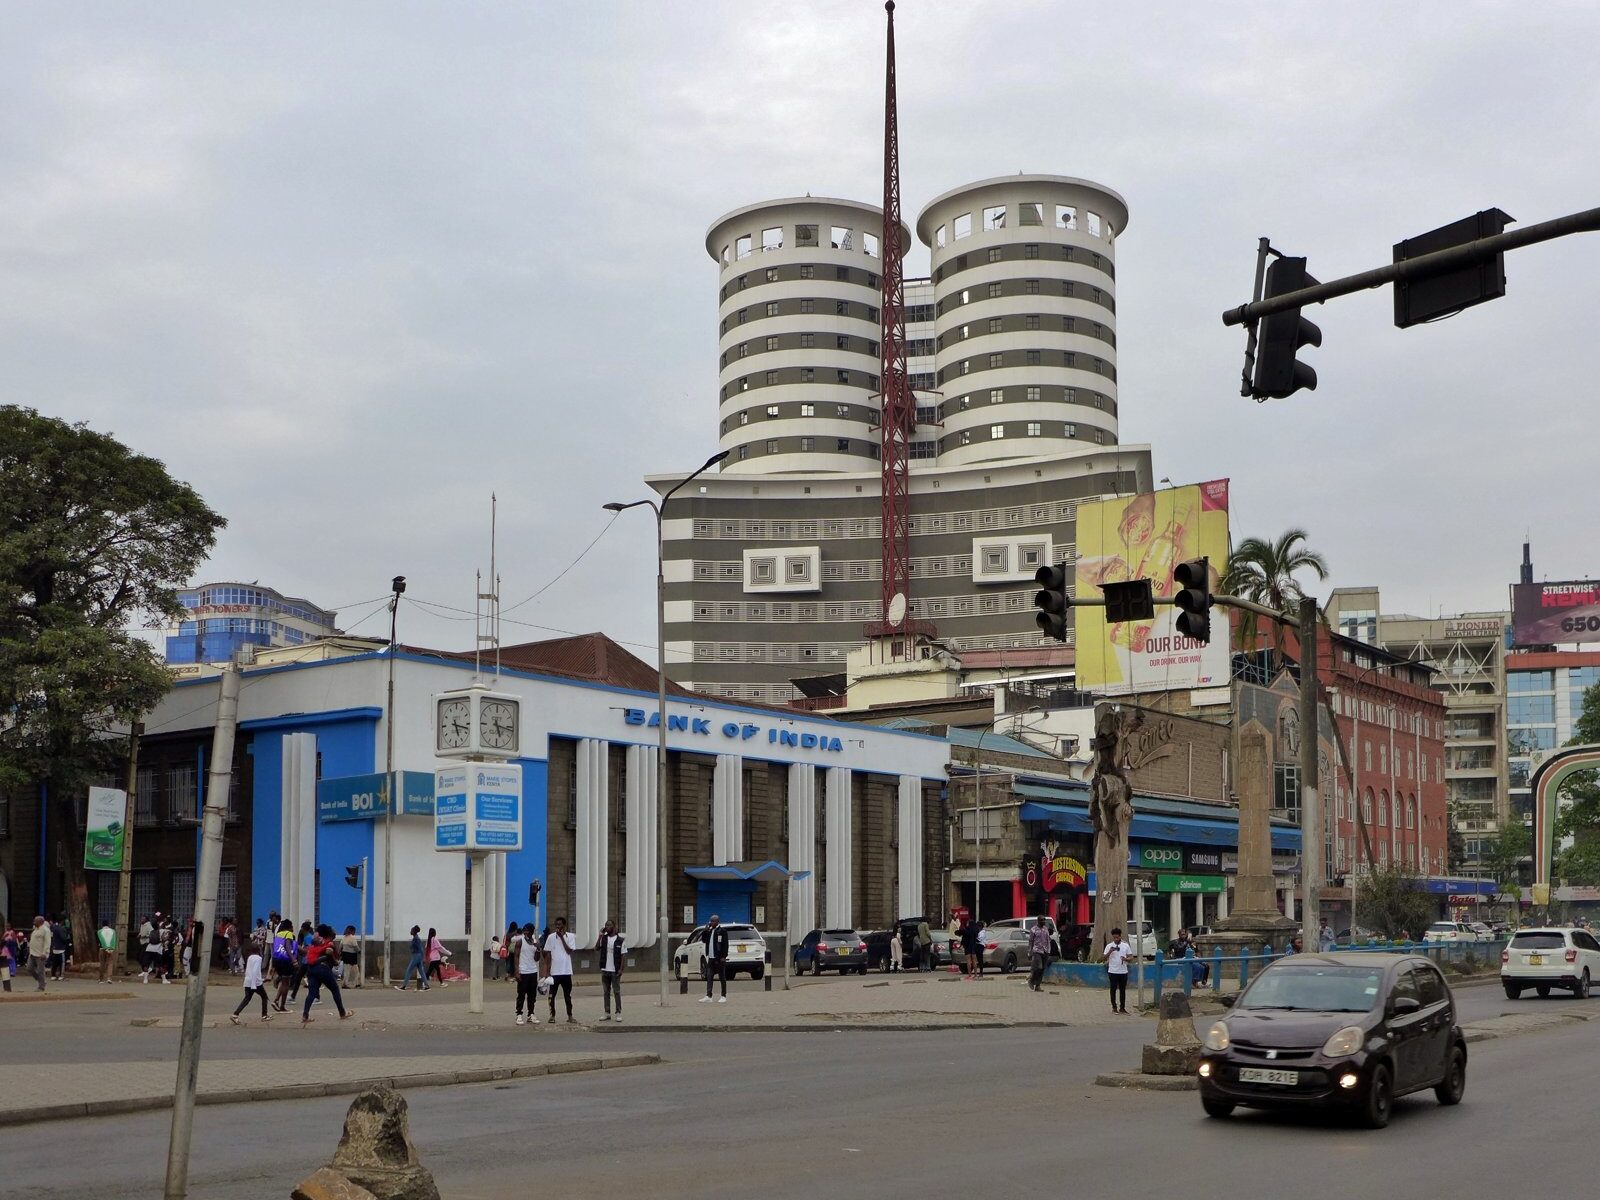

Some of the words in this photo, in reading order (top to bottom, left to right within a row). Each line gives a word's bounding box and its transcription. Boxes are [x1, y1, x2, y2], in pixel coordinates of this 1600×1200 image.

[213, 604, 250, 613] TOWERS
[1456, 621, 1500, 631] PIONEER
[1561, 615, 1600, 633] 650
[1475, 629, 1499, 637] STREET
[1146, 637, 1171, 654] OUR
[1149, 659, 1161, 667] OUR
[1178, 656, 1189, 664] OUR
[624, 708, 712, 736] BANK
[722, 722, 761, 741] OF
[768, 728, 844, 752] INDIA
[352, 792, 374, 810] BOI
[408, 794, 422, 803] Bank
[422, 795, 429, 803] of
[320, 801, 332, 810] Bank
[332, 801, 337, 809] of
[337, 800, 348, 808] India
[1144, 849, 1181, 864] oppo
[1191, 853, 1218, 866] SAMSUNG
[1179, 880, 1202, 889] Safaricom
[1450, 895, 1476, 904] Bata
